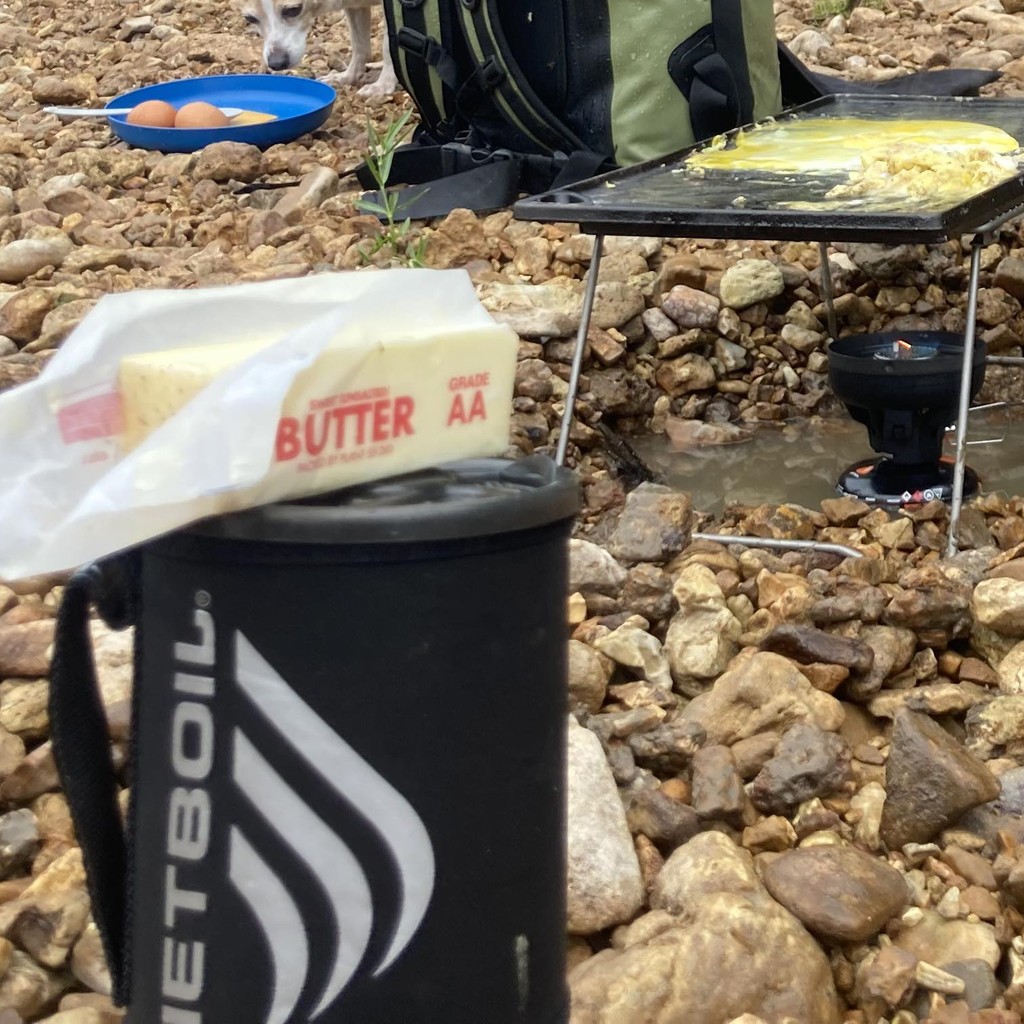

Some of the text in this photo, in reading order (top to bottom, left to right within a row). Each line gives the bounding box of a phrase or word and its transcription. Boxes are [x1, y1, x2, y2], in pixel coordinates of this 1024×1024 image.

[449, 371, 491, 391] GRADE
[447, 390, 487, 426] AA
[275, 396, 415, 462] BUTTER
